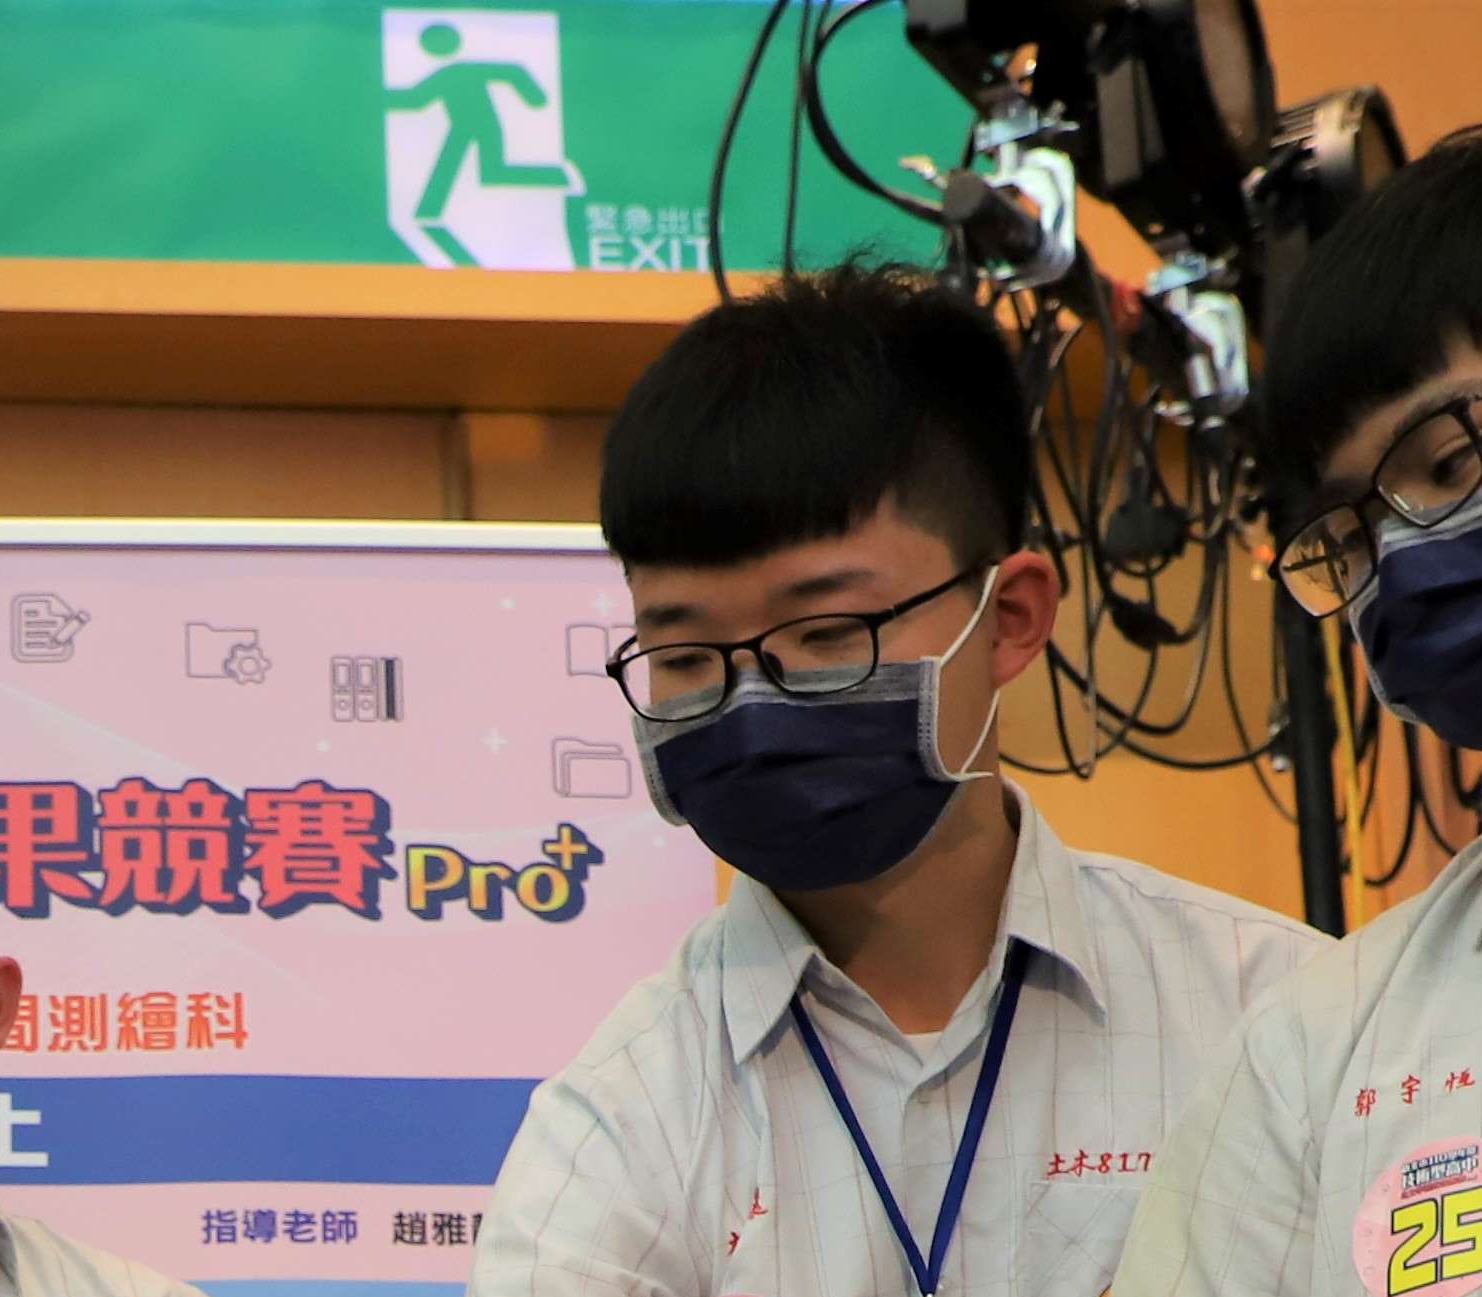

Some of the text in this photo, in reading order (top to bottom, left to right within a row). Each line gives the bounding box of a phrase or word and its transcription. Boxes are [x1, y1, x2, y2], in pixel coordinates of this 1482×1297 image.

[589, 233, 712, 272] EXIT
[202, 1208, 358, 1246] 指導老師
